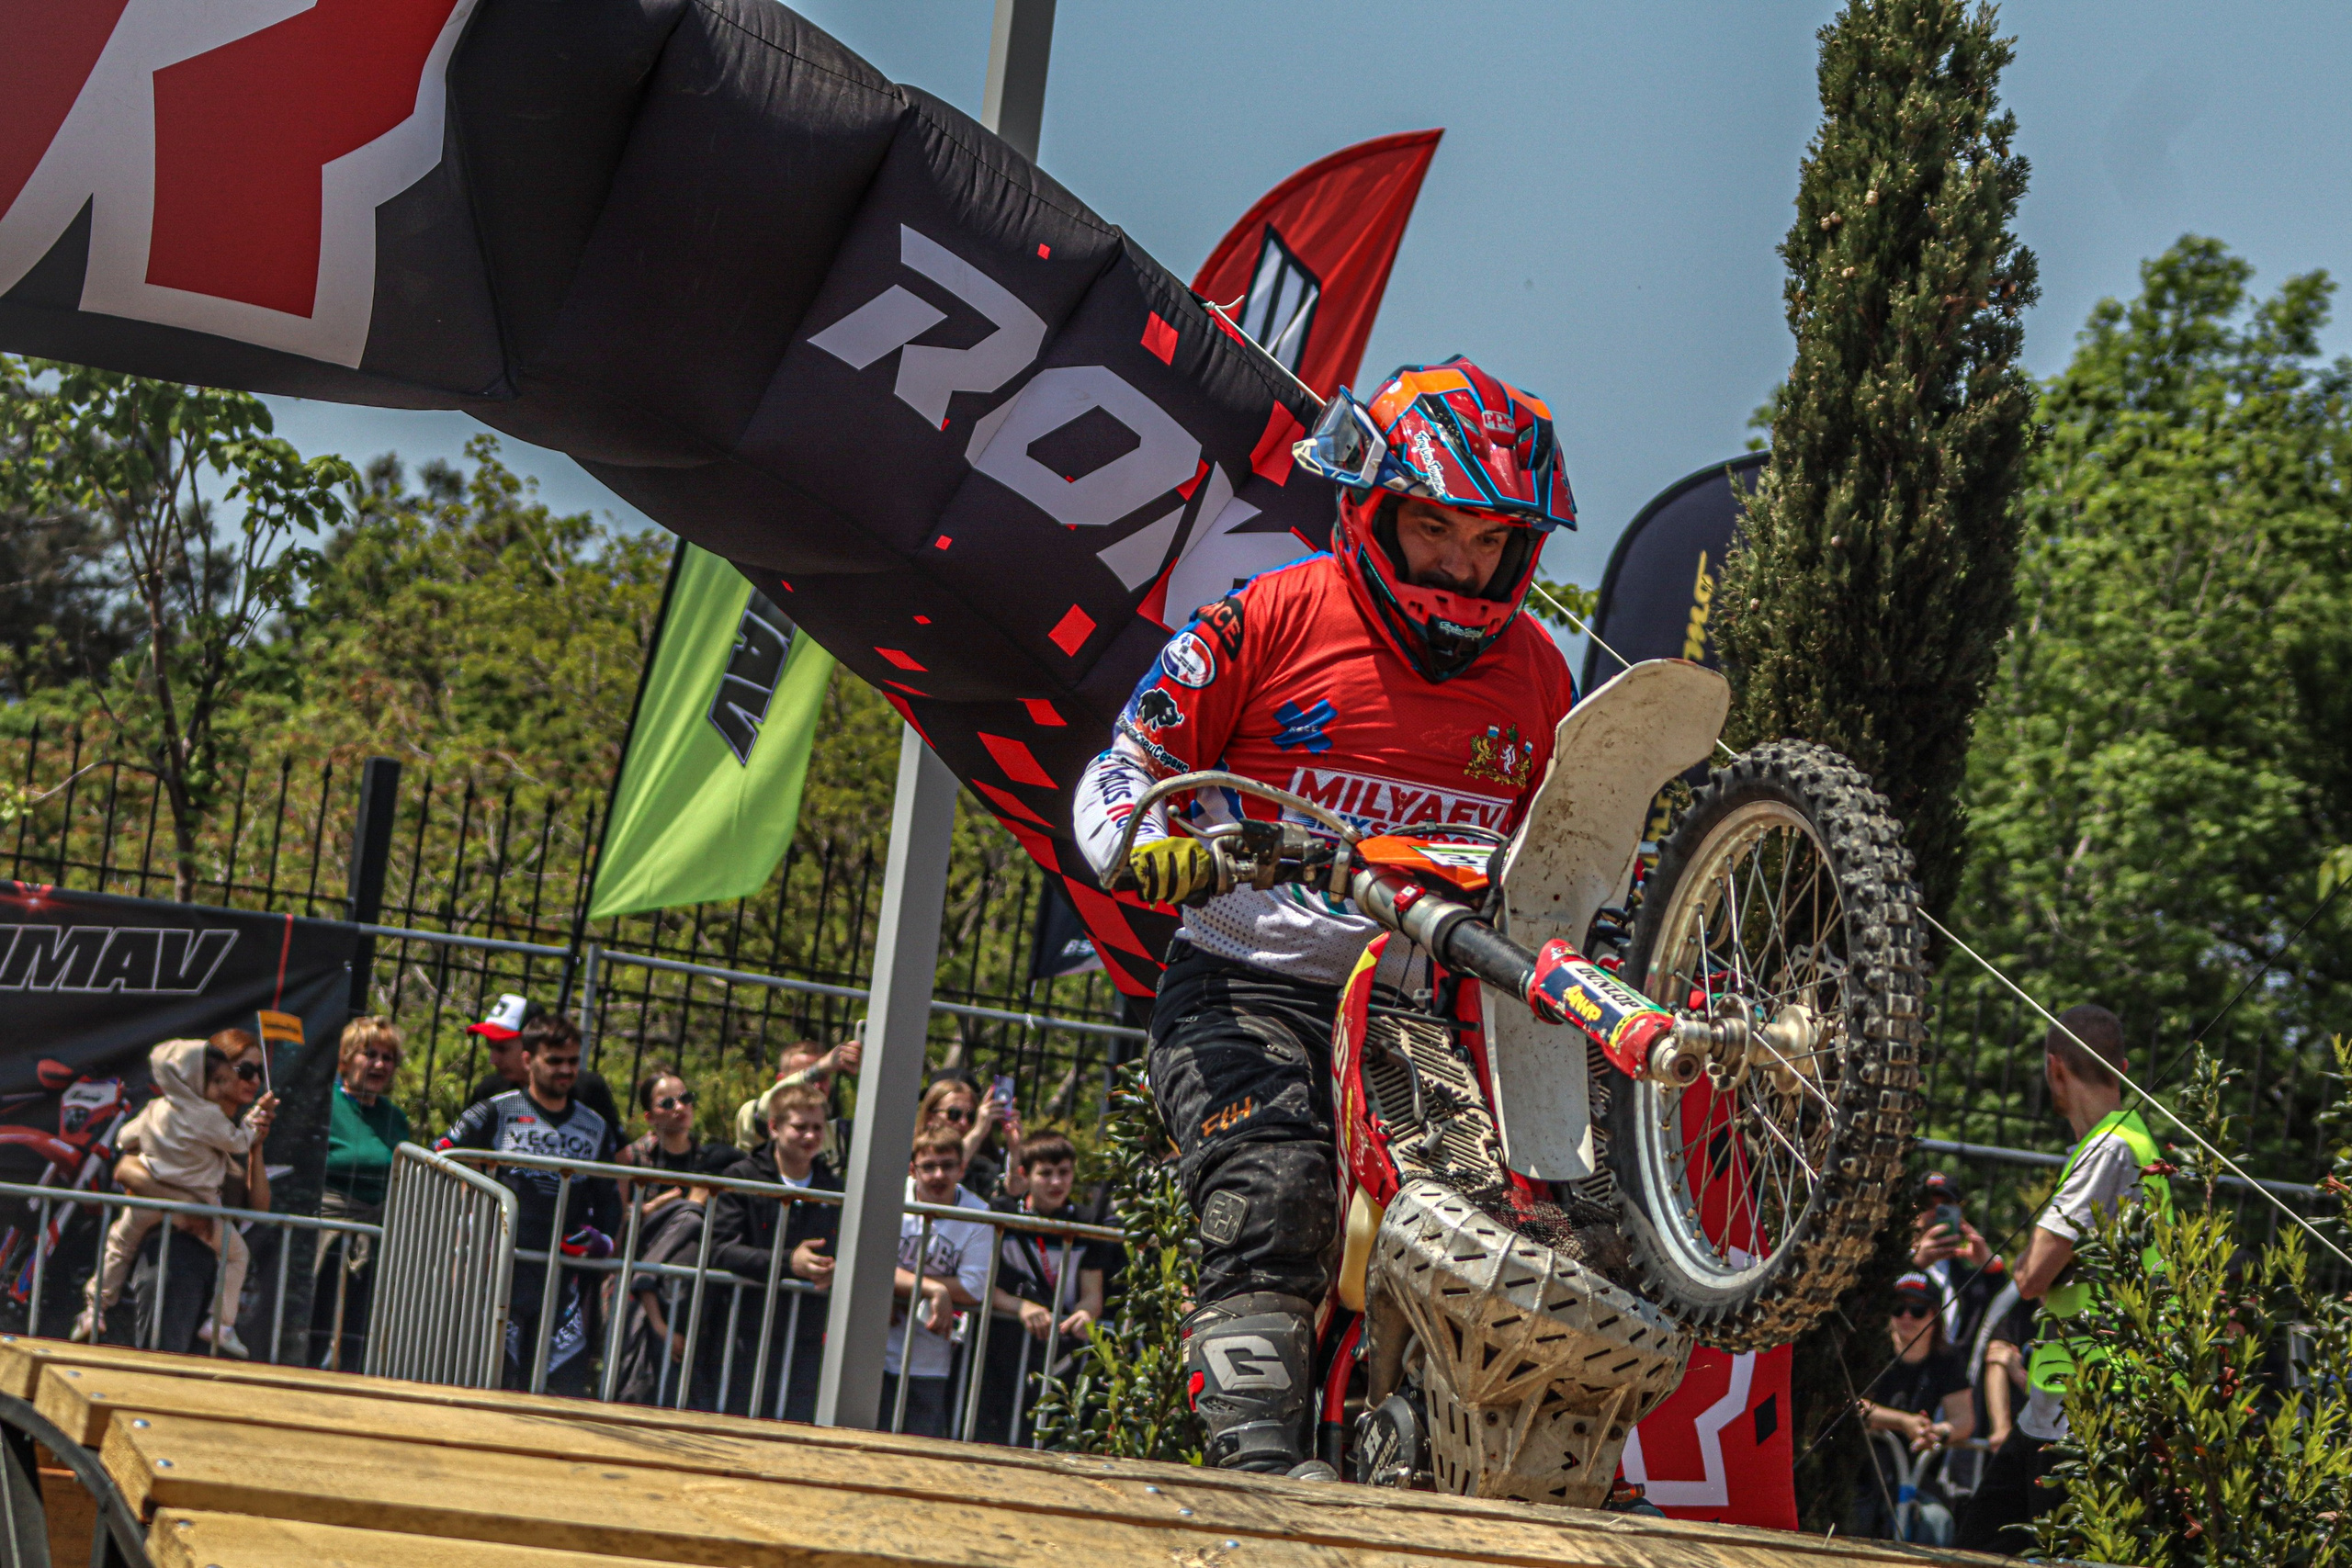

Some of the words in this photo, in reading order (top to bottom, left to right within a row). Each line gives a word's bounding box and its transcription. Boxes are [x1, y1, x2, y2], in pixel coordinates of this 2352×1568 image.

[1484, 412, 1514, 429] PPG
[0, 924, 242, 995] MAV
[1575, 967, 1642, 1009] DUNLOP
